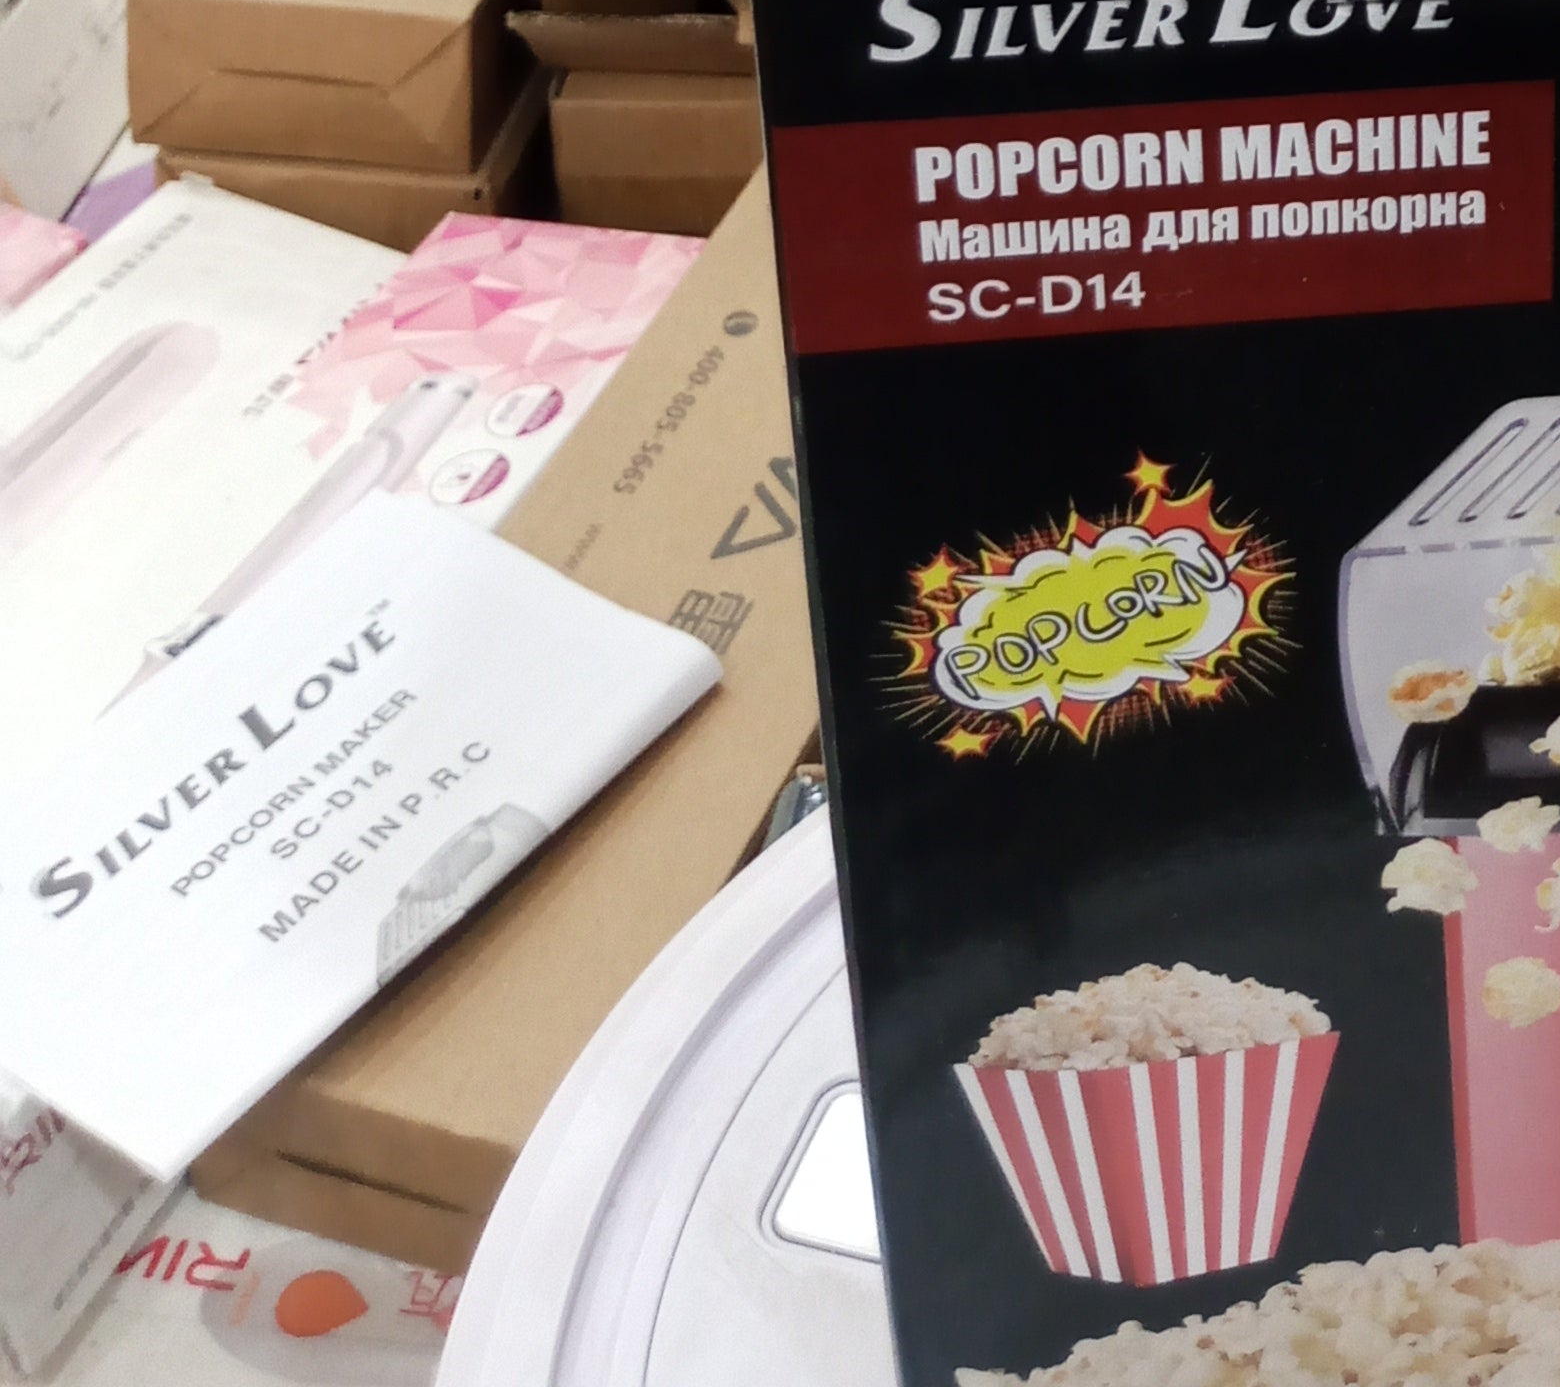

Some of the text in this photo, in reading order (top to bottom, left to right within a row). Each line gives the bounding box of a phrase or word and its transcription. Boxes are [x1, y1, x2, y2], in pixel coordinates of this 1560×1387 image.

[915, 110, 1492, 203] POPCORN MACHINE
[919, 190, 1487, 263] Машина для попкорна
[928, 271, 1146, 321] SC-D14
[944, 544, 1231, 702] POPCORN
[32, 748, 247, 919] SILVER
[238, 620, 397, 752] LOVE
[170, 688, 419, 899] POPCORN MAKER
[270, 757, 394, 861] SC-D14
[258, 848, 364, 944] MADE
[359, 814, 403, 854] IN
